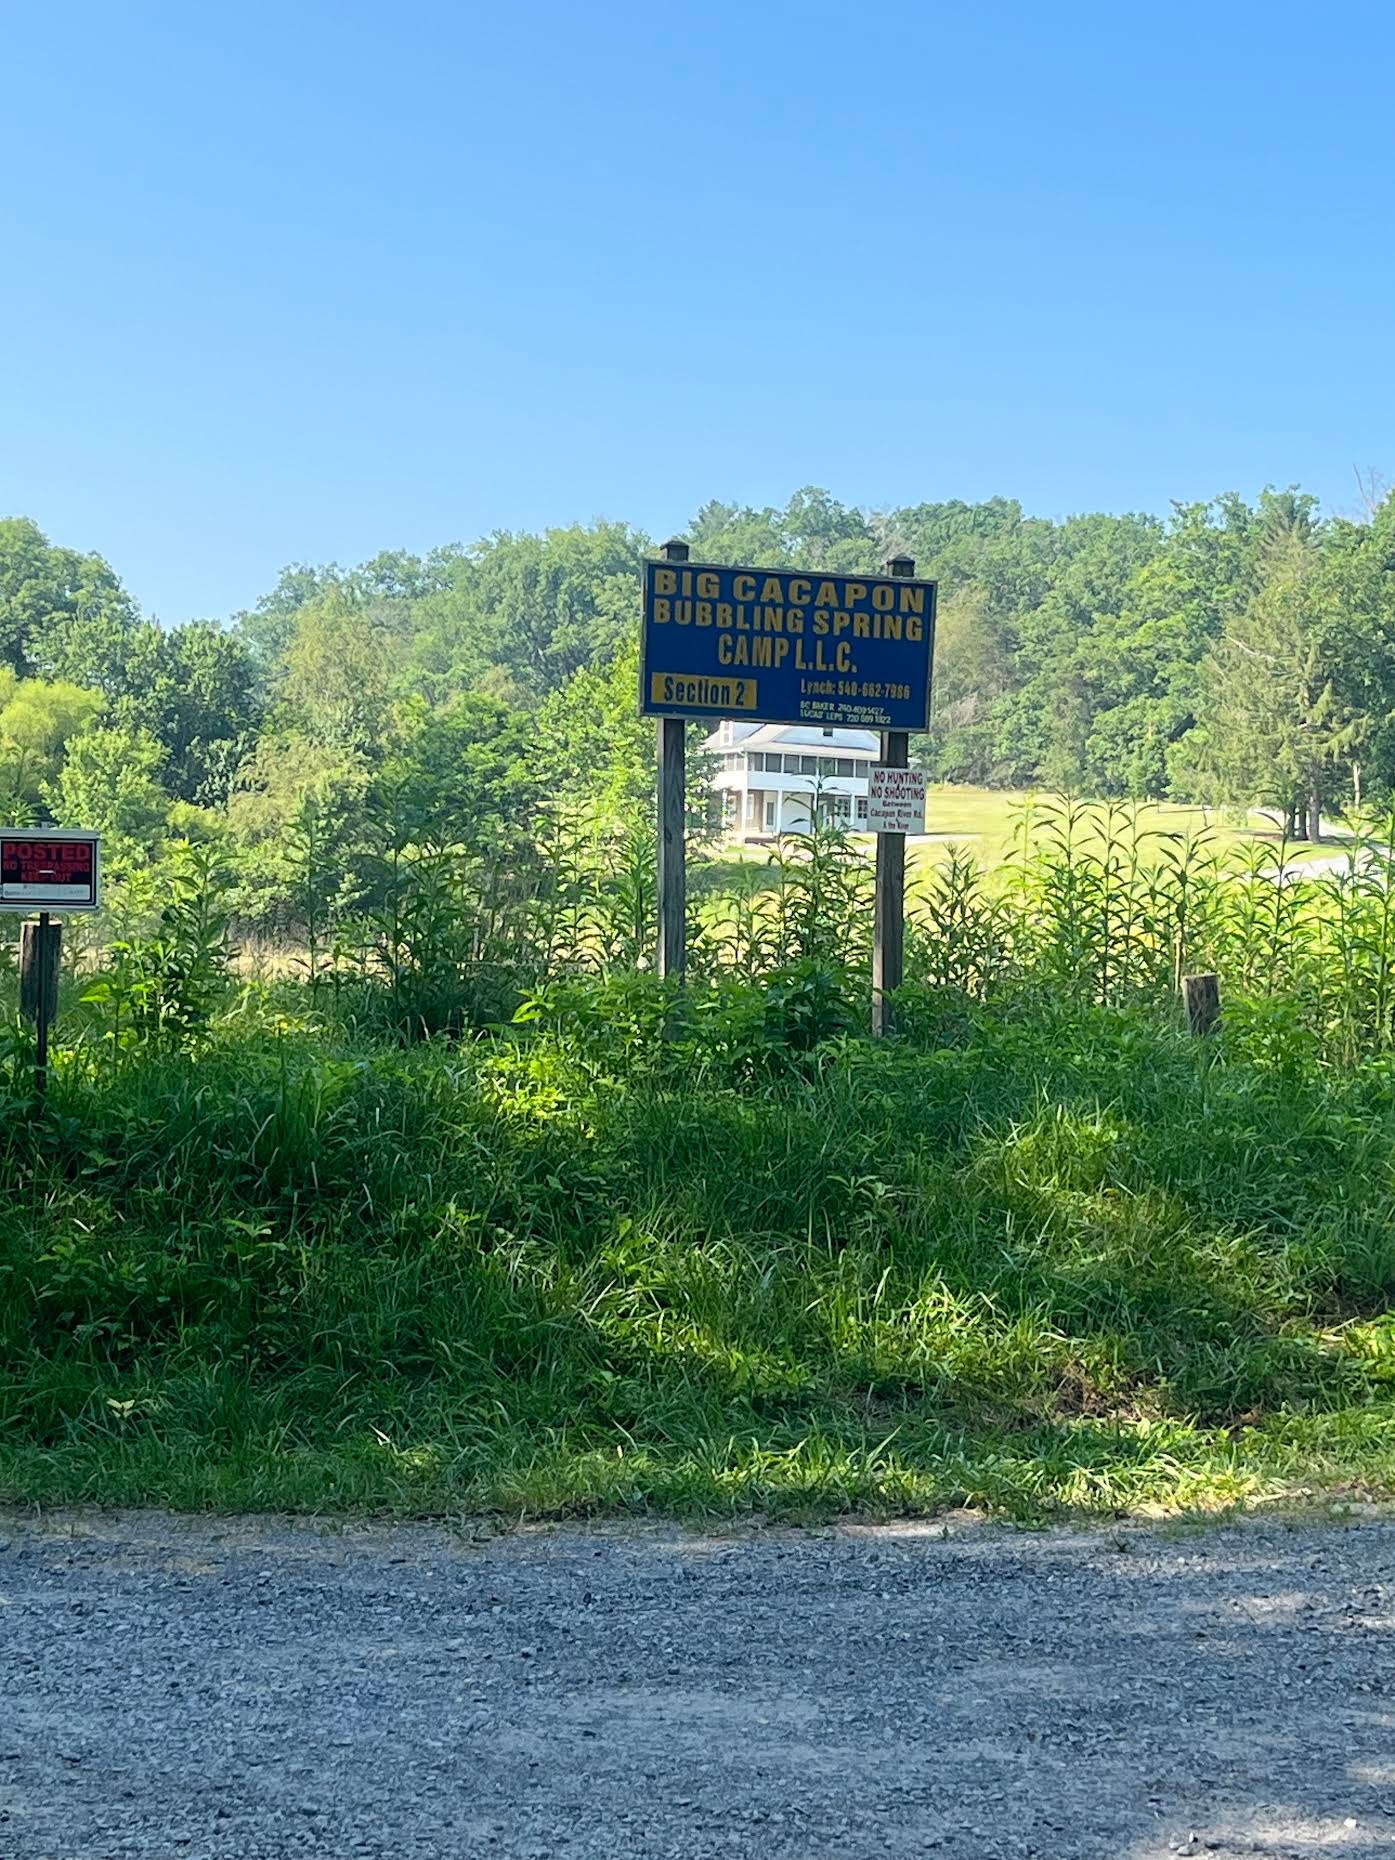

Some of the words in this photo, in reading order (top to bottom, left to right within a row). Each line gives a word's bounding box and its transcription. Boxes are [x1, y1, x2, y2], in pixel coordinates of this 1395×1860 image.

[653, 569, 720, 600] BIG
[732, 575, 925, 614] CACAPON
[652, 598, 805, 634] BUBBLING
[811, 609, 923, 642] SPRING
[718, 634, 790, 668] CAMP
[796, 639, 858, 673] L.L.C.
[664, 677, 730, 705] Section
[735, 681, 746, 706] 2
[800, 678, 836, 696] Lynch:
[874, 771, 885, 784] NO
[887, 772, 923, 785] HUNTING
[871, 786, 883, 799] NO
[884, 787, 925, 801] SHOOTING
[3, 843, 90, 861] POSTED
[3, 861, 18, 871] NO
